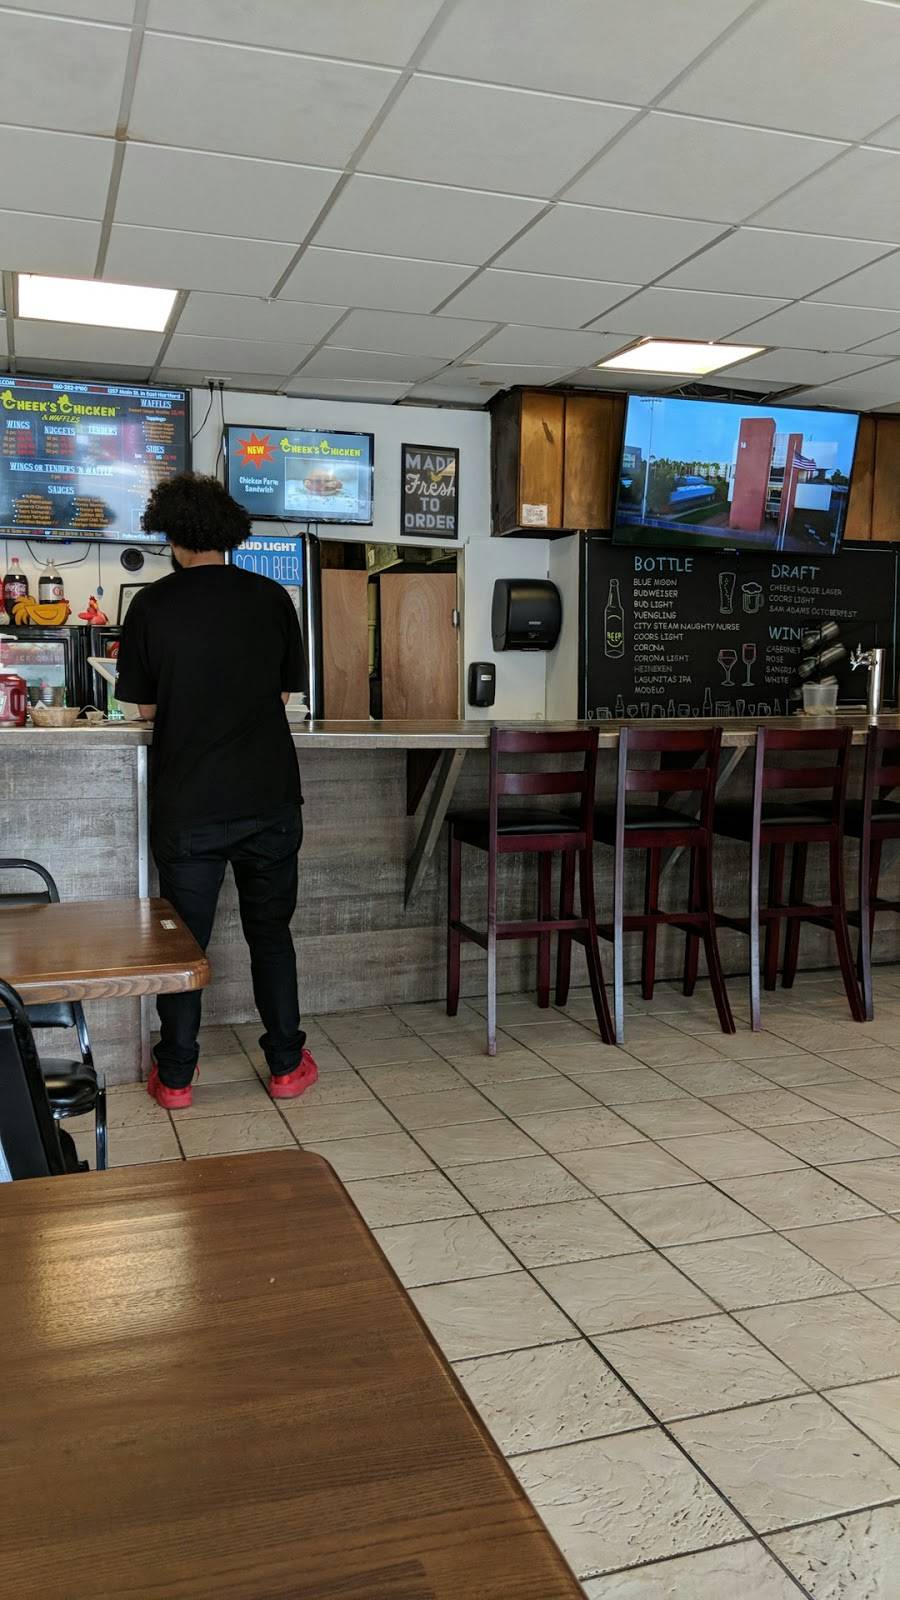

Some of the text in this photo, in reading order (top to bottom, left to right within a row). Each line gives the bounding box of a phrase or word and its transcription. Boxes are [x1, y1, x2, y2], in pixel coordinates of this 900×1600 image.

[1, 390, 116, 417] CHEEK'S CHICKEN
[140, 399, 172, 408] WAFFLES
[48, 414, 80, 424] WAFFLES
[6, 420, 30, 430] WINGS
[44, 426, 76, 436] NUGGETS
[145, 445, 165, 454] SIDES
[246, 445, 265, 455] NEW
[280, 439, 360, 456] CHEEK'S CHICKEN
[10, 462, 34, 472] WINGS
[34, 464, 43, 472] OR
[44, 464, 75, 474] TENDERS
[240, 476, 262, 485] Chicken
[405, 474, 456, 496] Fresh
[48, 485, 74, 495] SAUCES
[245, 486, 274, 494] Sandwich
[420, 497, 440, 512] TO
[404, 512, 455, 529] ORDER
[238, 541, 297, 552] BUD LIGHT
[236, 554, 300, 580] COLD BEER
[634, 556, 694, 572] BOTTLE
[771, 564, 820, 580] DRAFT
[633, 578, 678, 586] BLUE MOON
[633, 590, 679, 598] BUDWEISER
[770, 584, 842, 596] CHEEKS HOUSE LAGER
[634, 600, 649, 608] BUD
[768, 594, 815, 604] COORS LIGHT
[633, 611, 678, 620] YUENGLING
[786, 606, 810, 615] ADAMS
[811, 607, 858, 618] OCTOBERFEST
[653, 622, 680, 630] STEAM
[680, 623, 716, 631] NAUGHTY
[716, 623, 740, 631] NURSE
[633, 633, 684, 641] COORS LIGHT
[633, 644, 665, 652] CORONA
[766, 645, 801, 655] CABERNET
[634, 654, 690, 662] CORONA LIGHT
[634, 665, 672, 673] HEINEKEN
[766, 665, 796, 674] SANGRIA
[634, 676, 678, 684] LAGUNITAS
[765, 676, 789, 684] WHITE
[634, 686, 665, 694] MODELO
